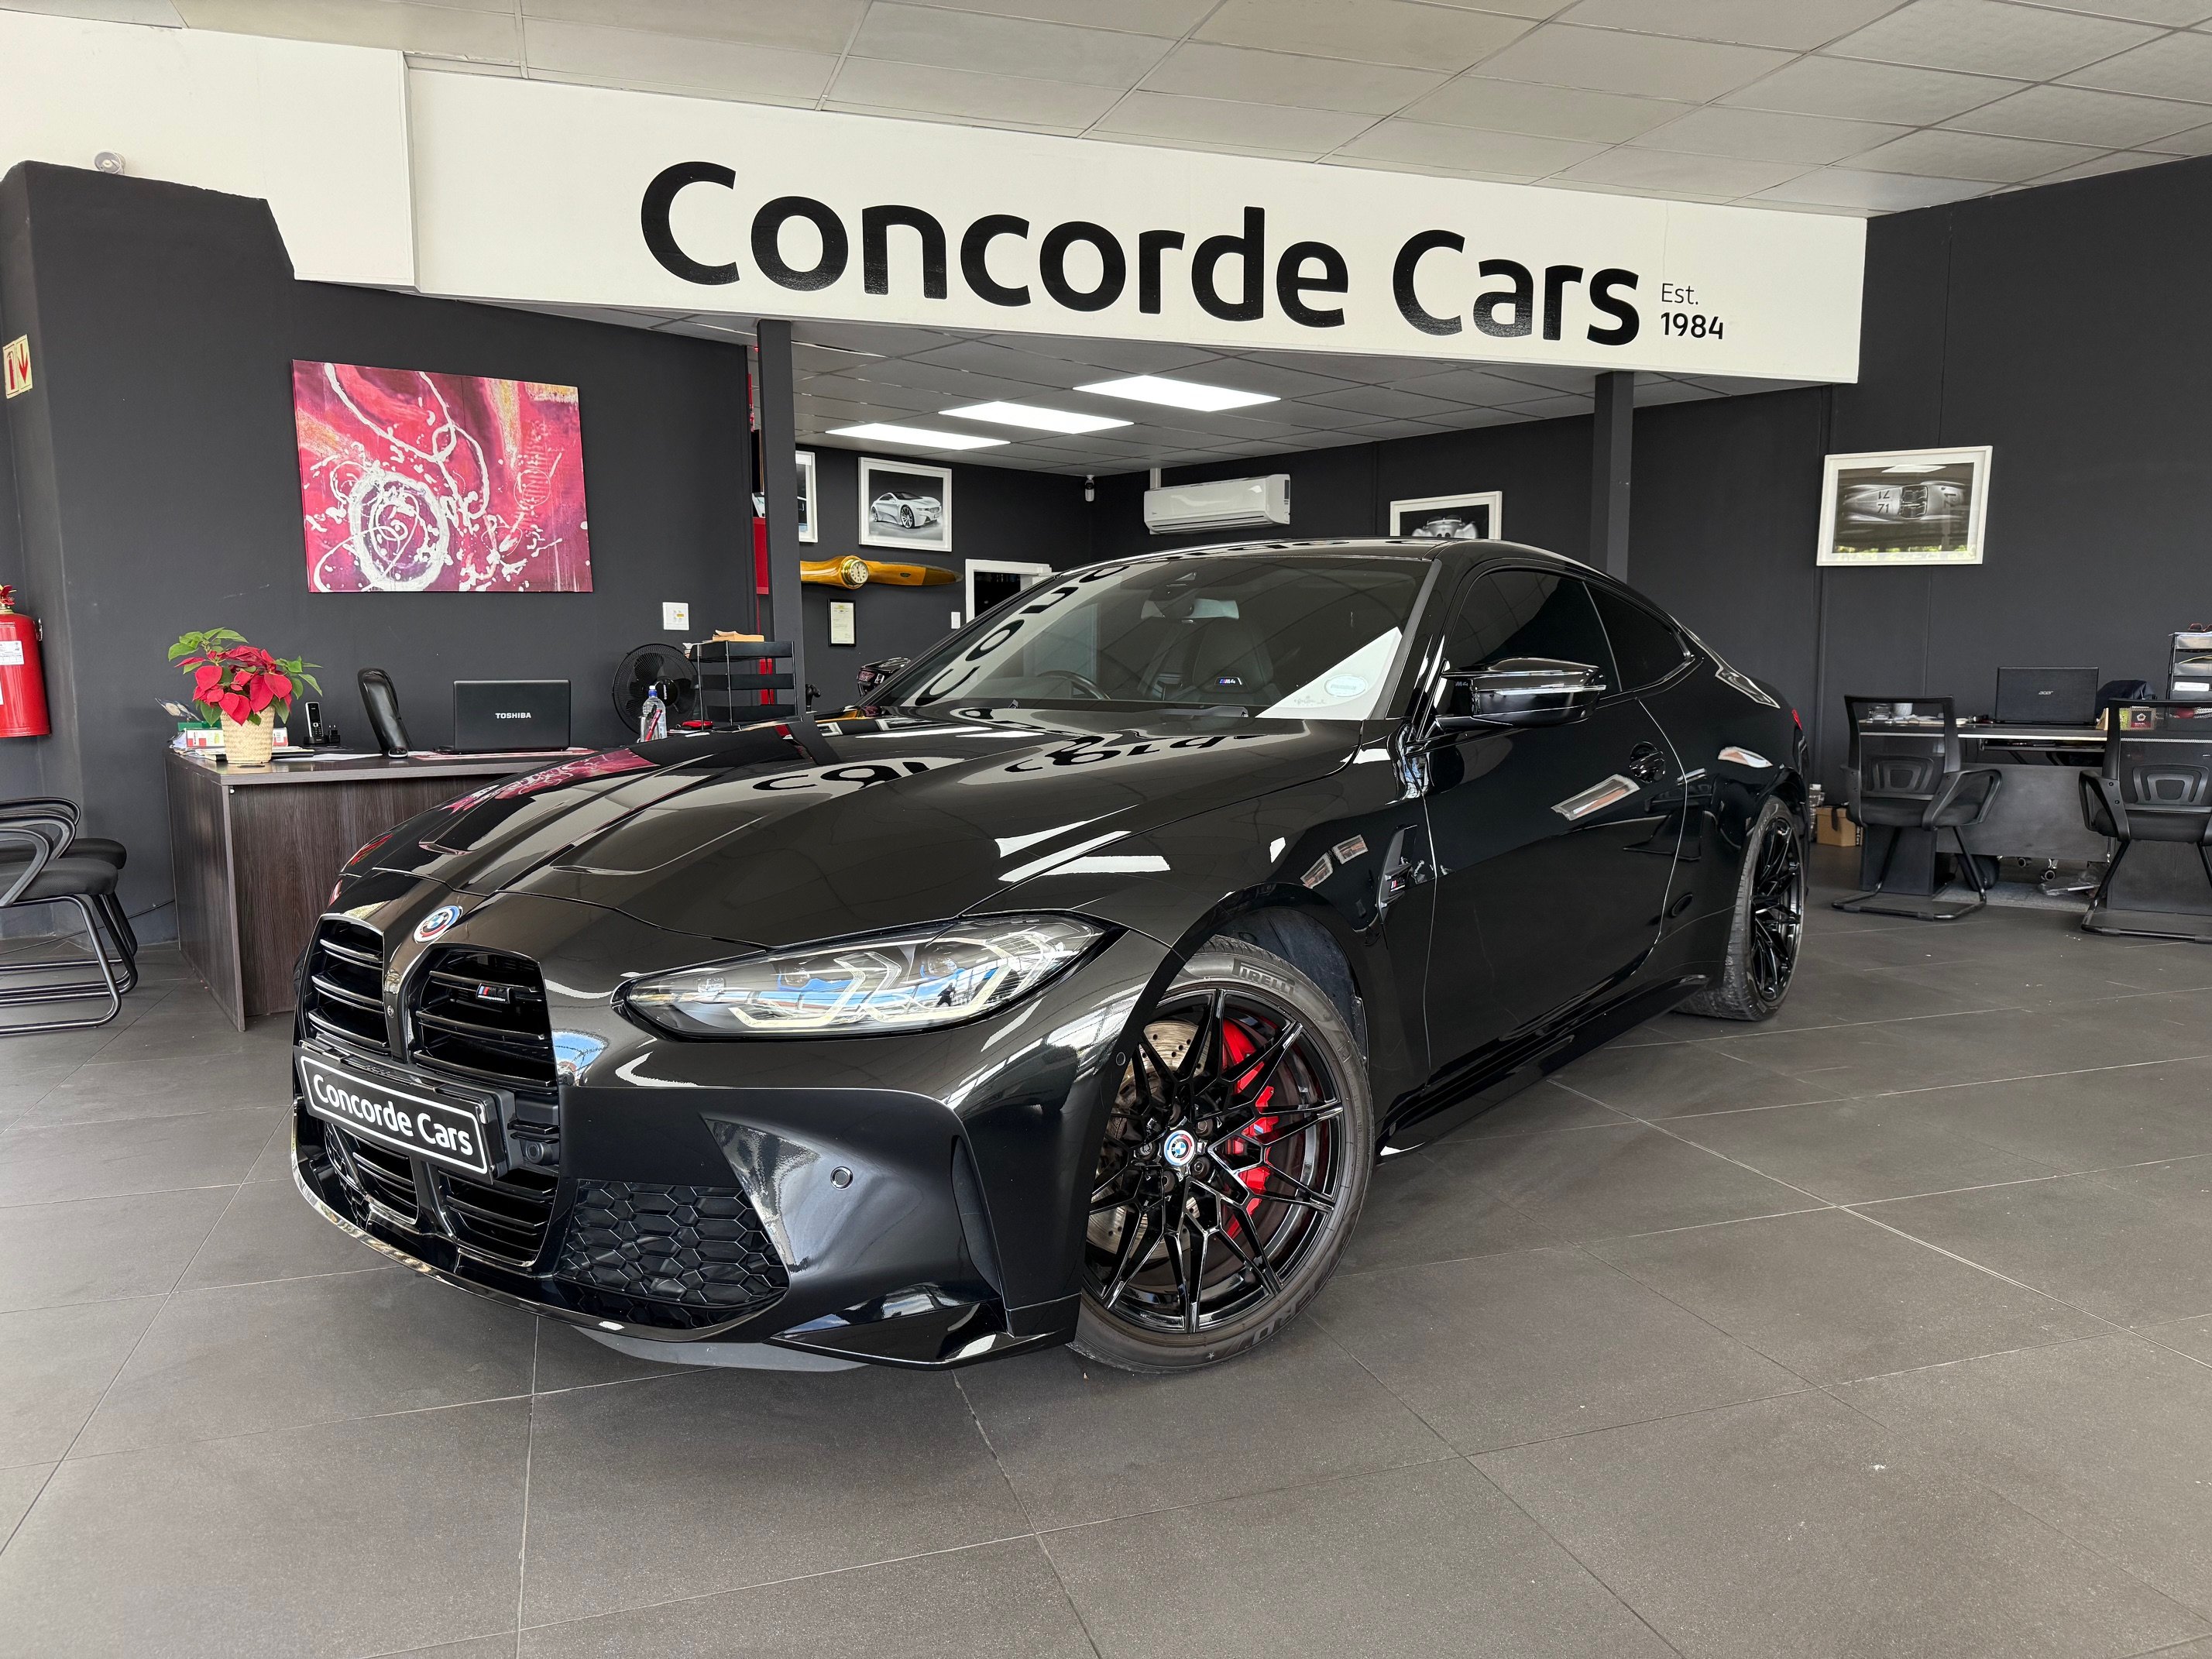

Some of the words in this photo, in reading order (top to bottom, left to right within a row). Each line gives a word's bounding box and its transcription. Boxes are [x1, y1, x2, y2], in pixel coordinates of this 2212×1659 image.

[641, 161, 1348, 328] Concorde
[1393, 229, 1640, 346] Cars
[1661, 283, 1699, 305] Est.
[1660, 312, 1724, 340] 1984
[1877, 503, 1889, 514] 71
[1231, 957, 1296, 996] PIRELLI
[313, 1073, 414, 1137] Concorde
[417, 1112, 473, 1156] Cars
